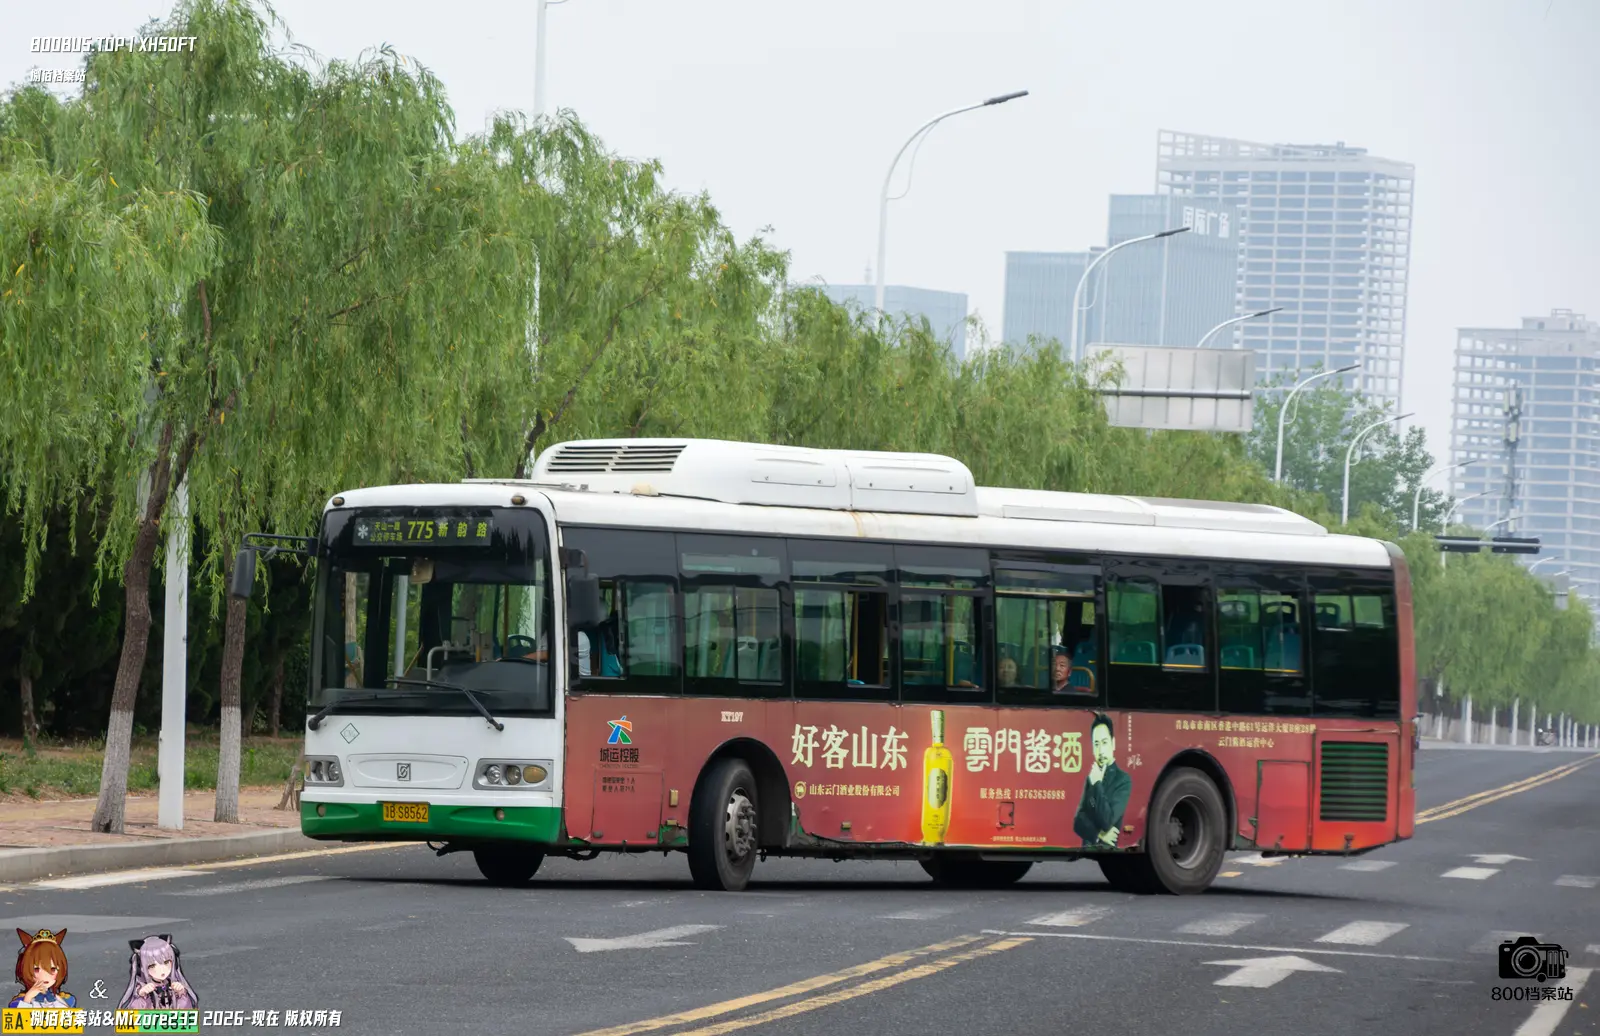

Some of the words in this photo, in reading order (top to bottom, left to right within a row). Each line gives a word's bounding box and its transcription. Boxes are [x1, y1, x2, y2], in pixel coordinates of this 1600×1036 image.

[407, 520, 434, 540] 775
[438, 521, 488, 538] 新韵路
[600, 747, 640, 763] 城运控股
[791, 724, 909, 771] 好客山东
[809, 784, 900, 797] 山东云门酒业股份有限公司
[980, 788, 1012, 800] 服务热线
[1015, 788, 1066, 800] 18763636988
